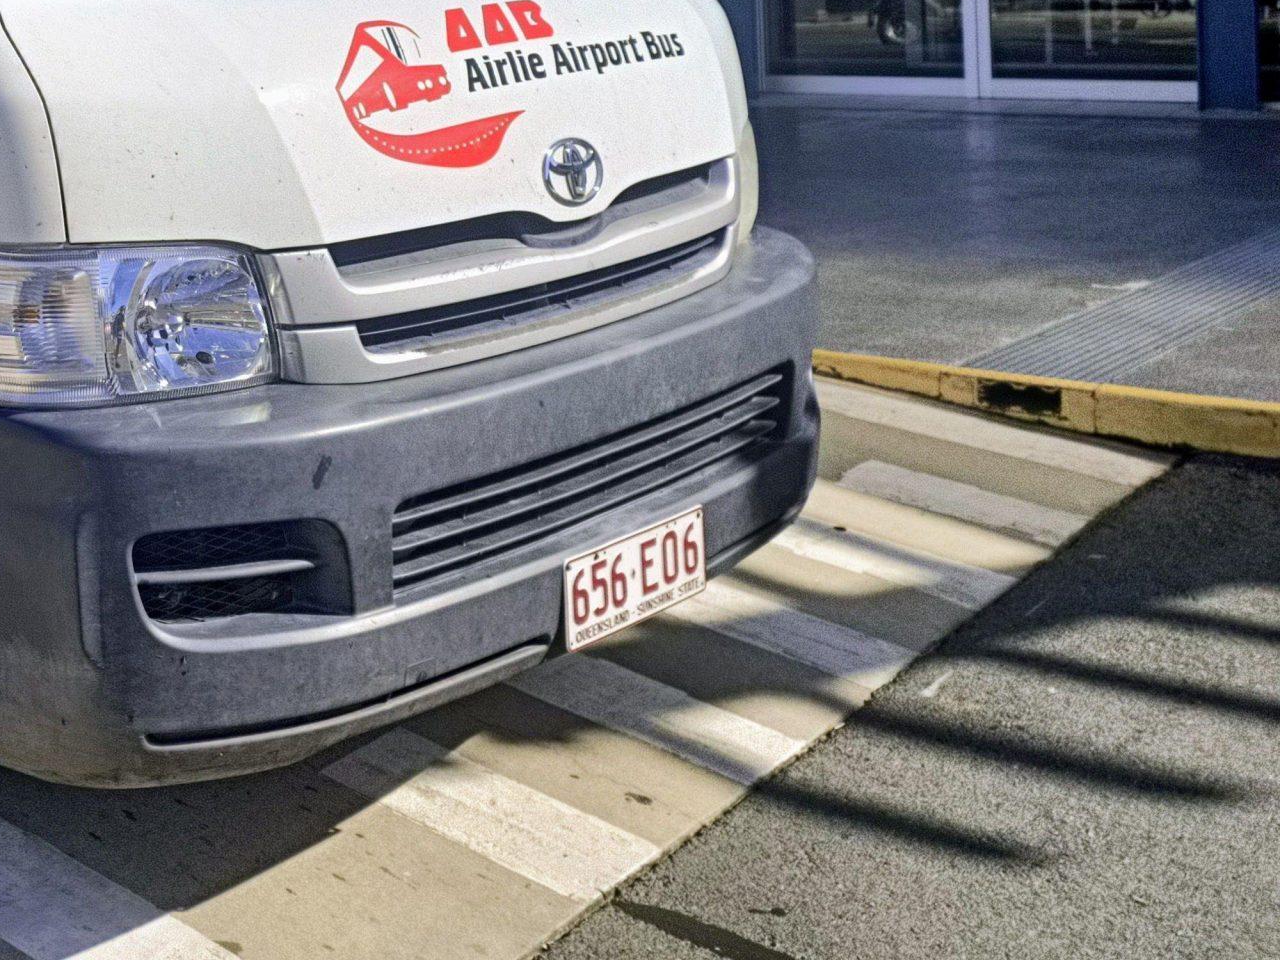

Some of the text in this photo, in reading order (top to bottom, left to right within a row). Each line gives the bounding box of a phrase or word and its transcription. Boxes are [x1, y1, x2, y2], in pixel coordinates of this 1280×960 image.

[463, 29, 685, 93] Airlie Airport Bus
[575, 579, 700, 644] QUEENSLAND SUNSHINE STATE
